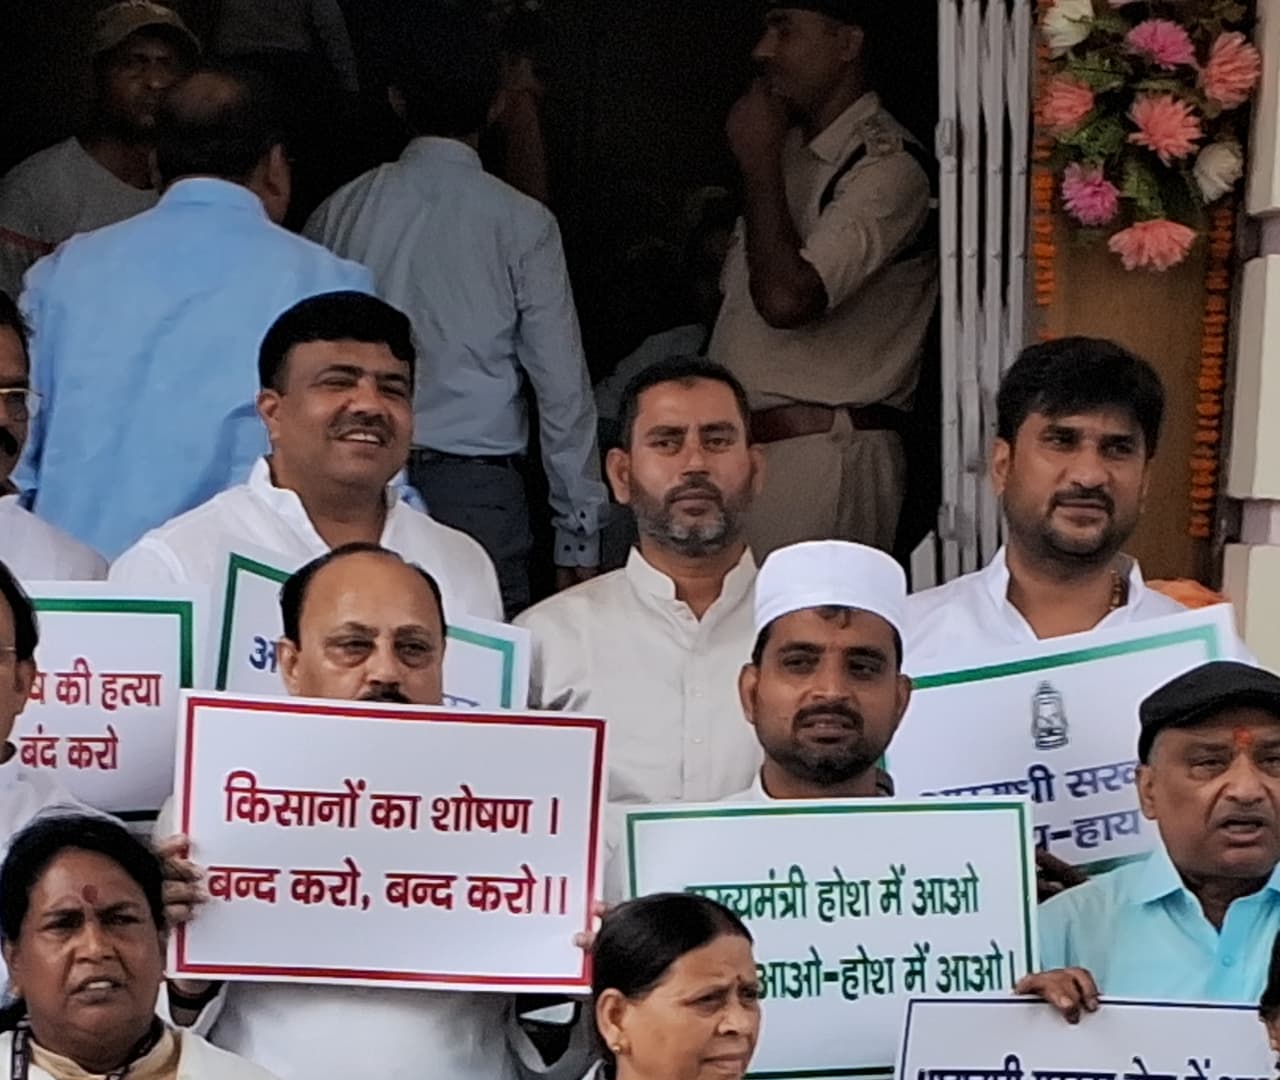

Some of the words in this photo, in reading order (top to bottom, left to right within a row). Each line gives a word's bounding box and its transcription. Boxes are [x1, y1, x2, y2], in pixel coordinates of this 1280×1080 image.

[56, 657, 92, 706] की
[100, 674, 162, 710] हत्या
[20, 724, 60, 769] बंद
[66, 725, 119, 770] करो
[224, 770, 366, 828] किसानों
[370, 793, 421, 830] का
[431, 784, 533, 834] शोषण
[207, 866, 280, 902] बन्द
[290, 857, 370, 911] करो,
[385, 873, 457, 910] बन्द
[816, 866, 870, 922] होश
[878, 864, 906, 915] में
[912, 862, 979, 914] आओ
[903, 941, 930, 993] में
